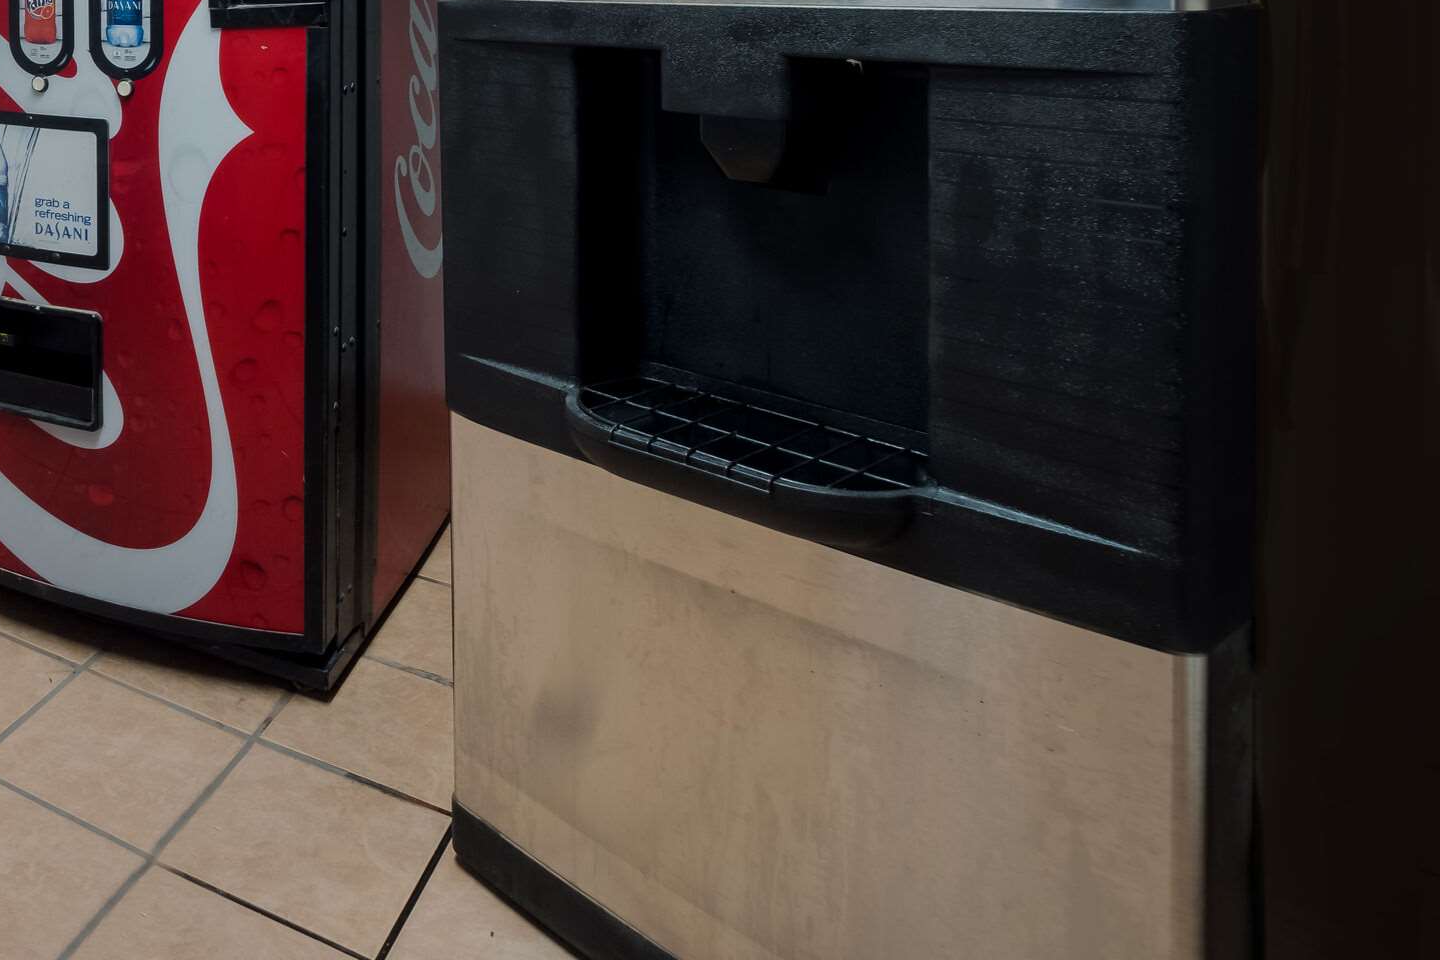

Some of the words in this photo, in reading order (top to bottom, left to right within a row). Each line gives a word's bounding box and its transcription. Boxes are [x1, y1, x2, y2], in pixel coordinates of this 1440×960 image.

[108, 0, 141, 11] DASANI
[35, 198, 60, 209] grab
[62, 201, 70, 209] a
[35, 209, 91, 226] refreshing
[35, 222, 89, 241] DASANI
